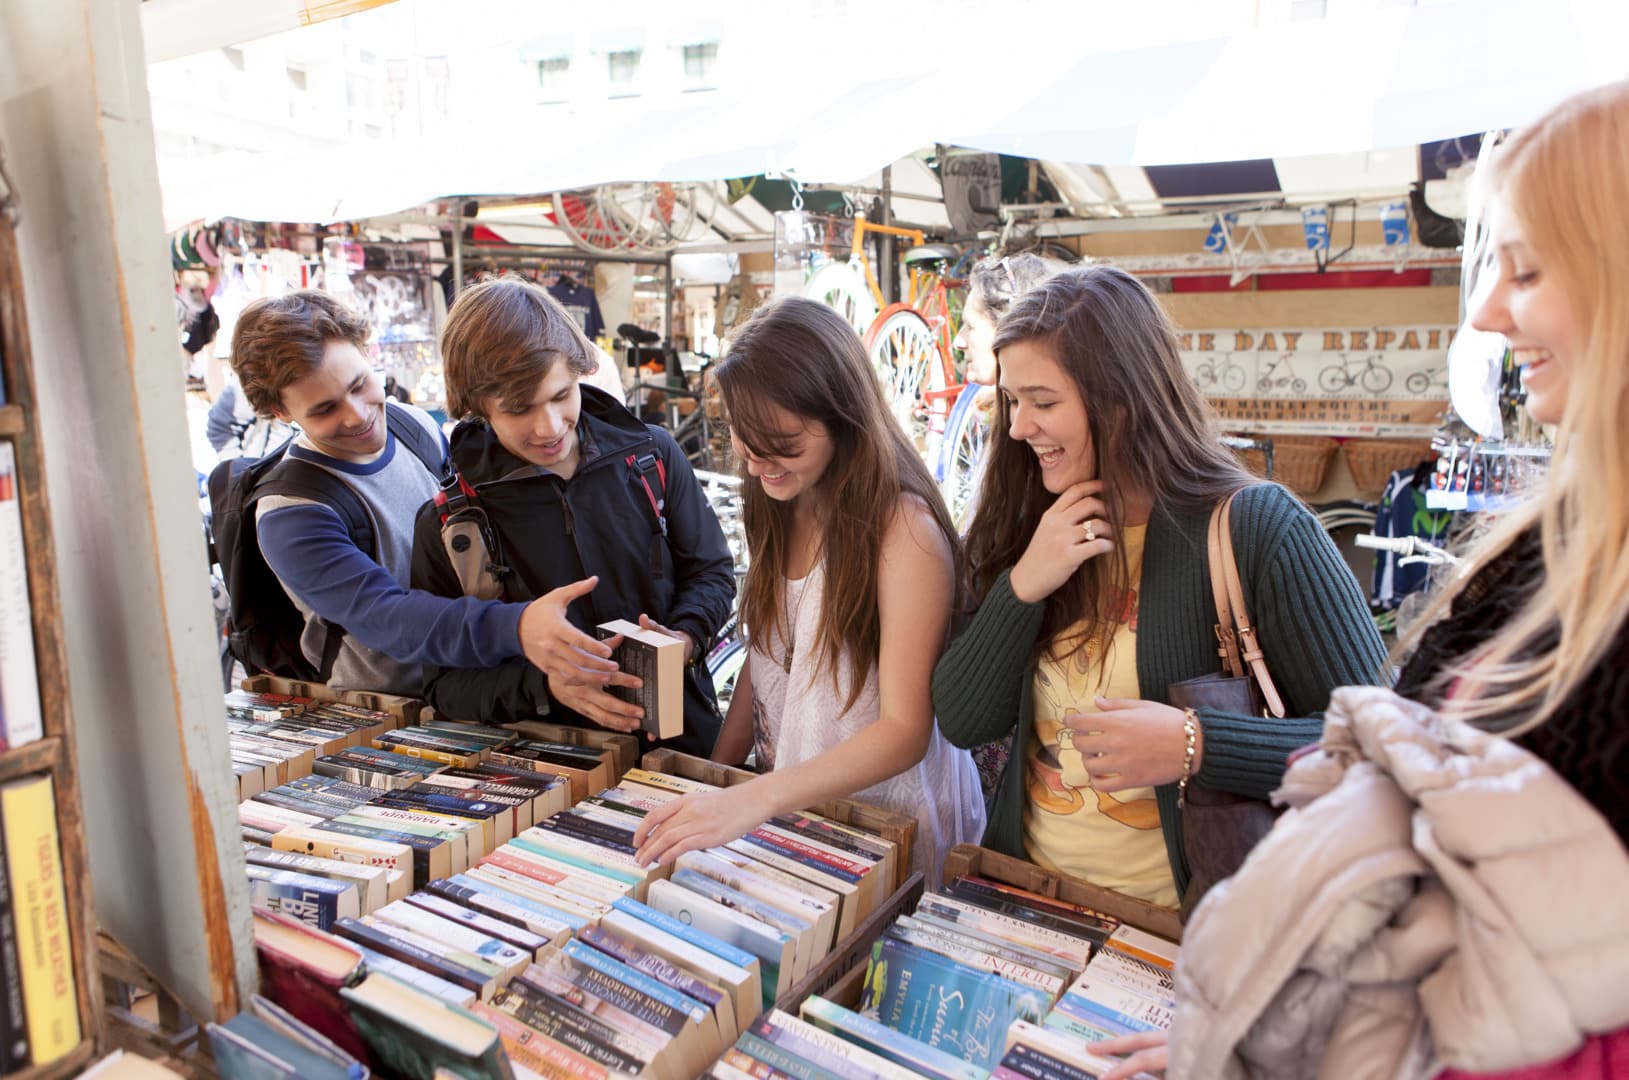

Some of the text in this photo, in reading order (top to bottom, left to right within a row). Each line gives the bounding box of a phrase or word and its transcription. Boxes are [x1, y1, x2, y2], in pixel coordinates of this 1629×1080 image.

[1175, 332, 1216, 352] NE
[1233, 331, 1302, 352] DAY
[379, 810, 440, 825] DARKSIDE
